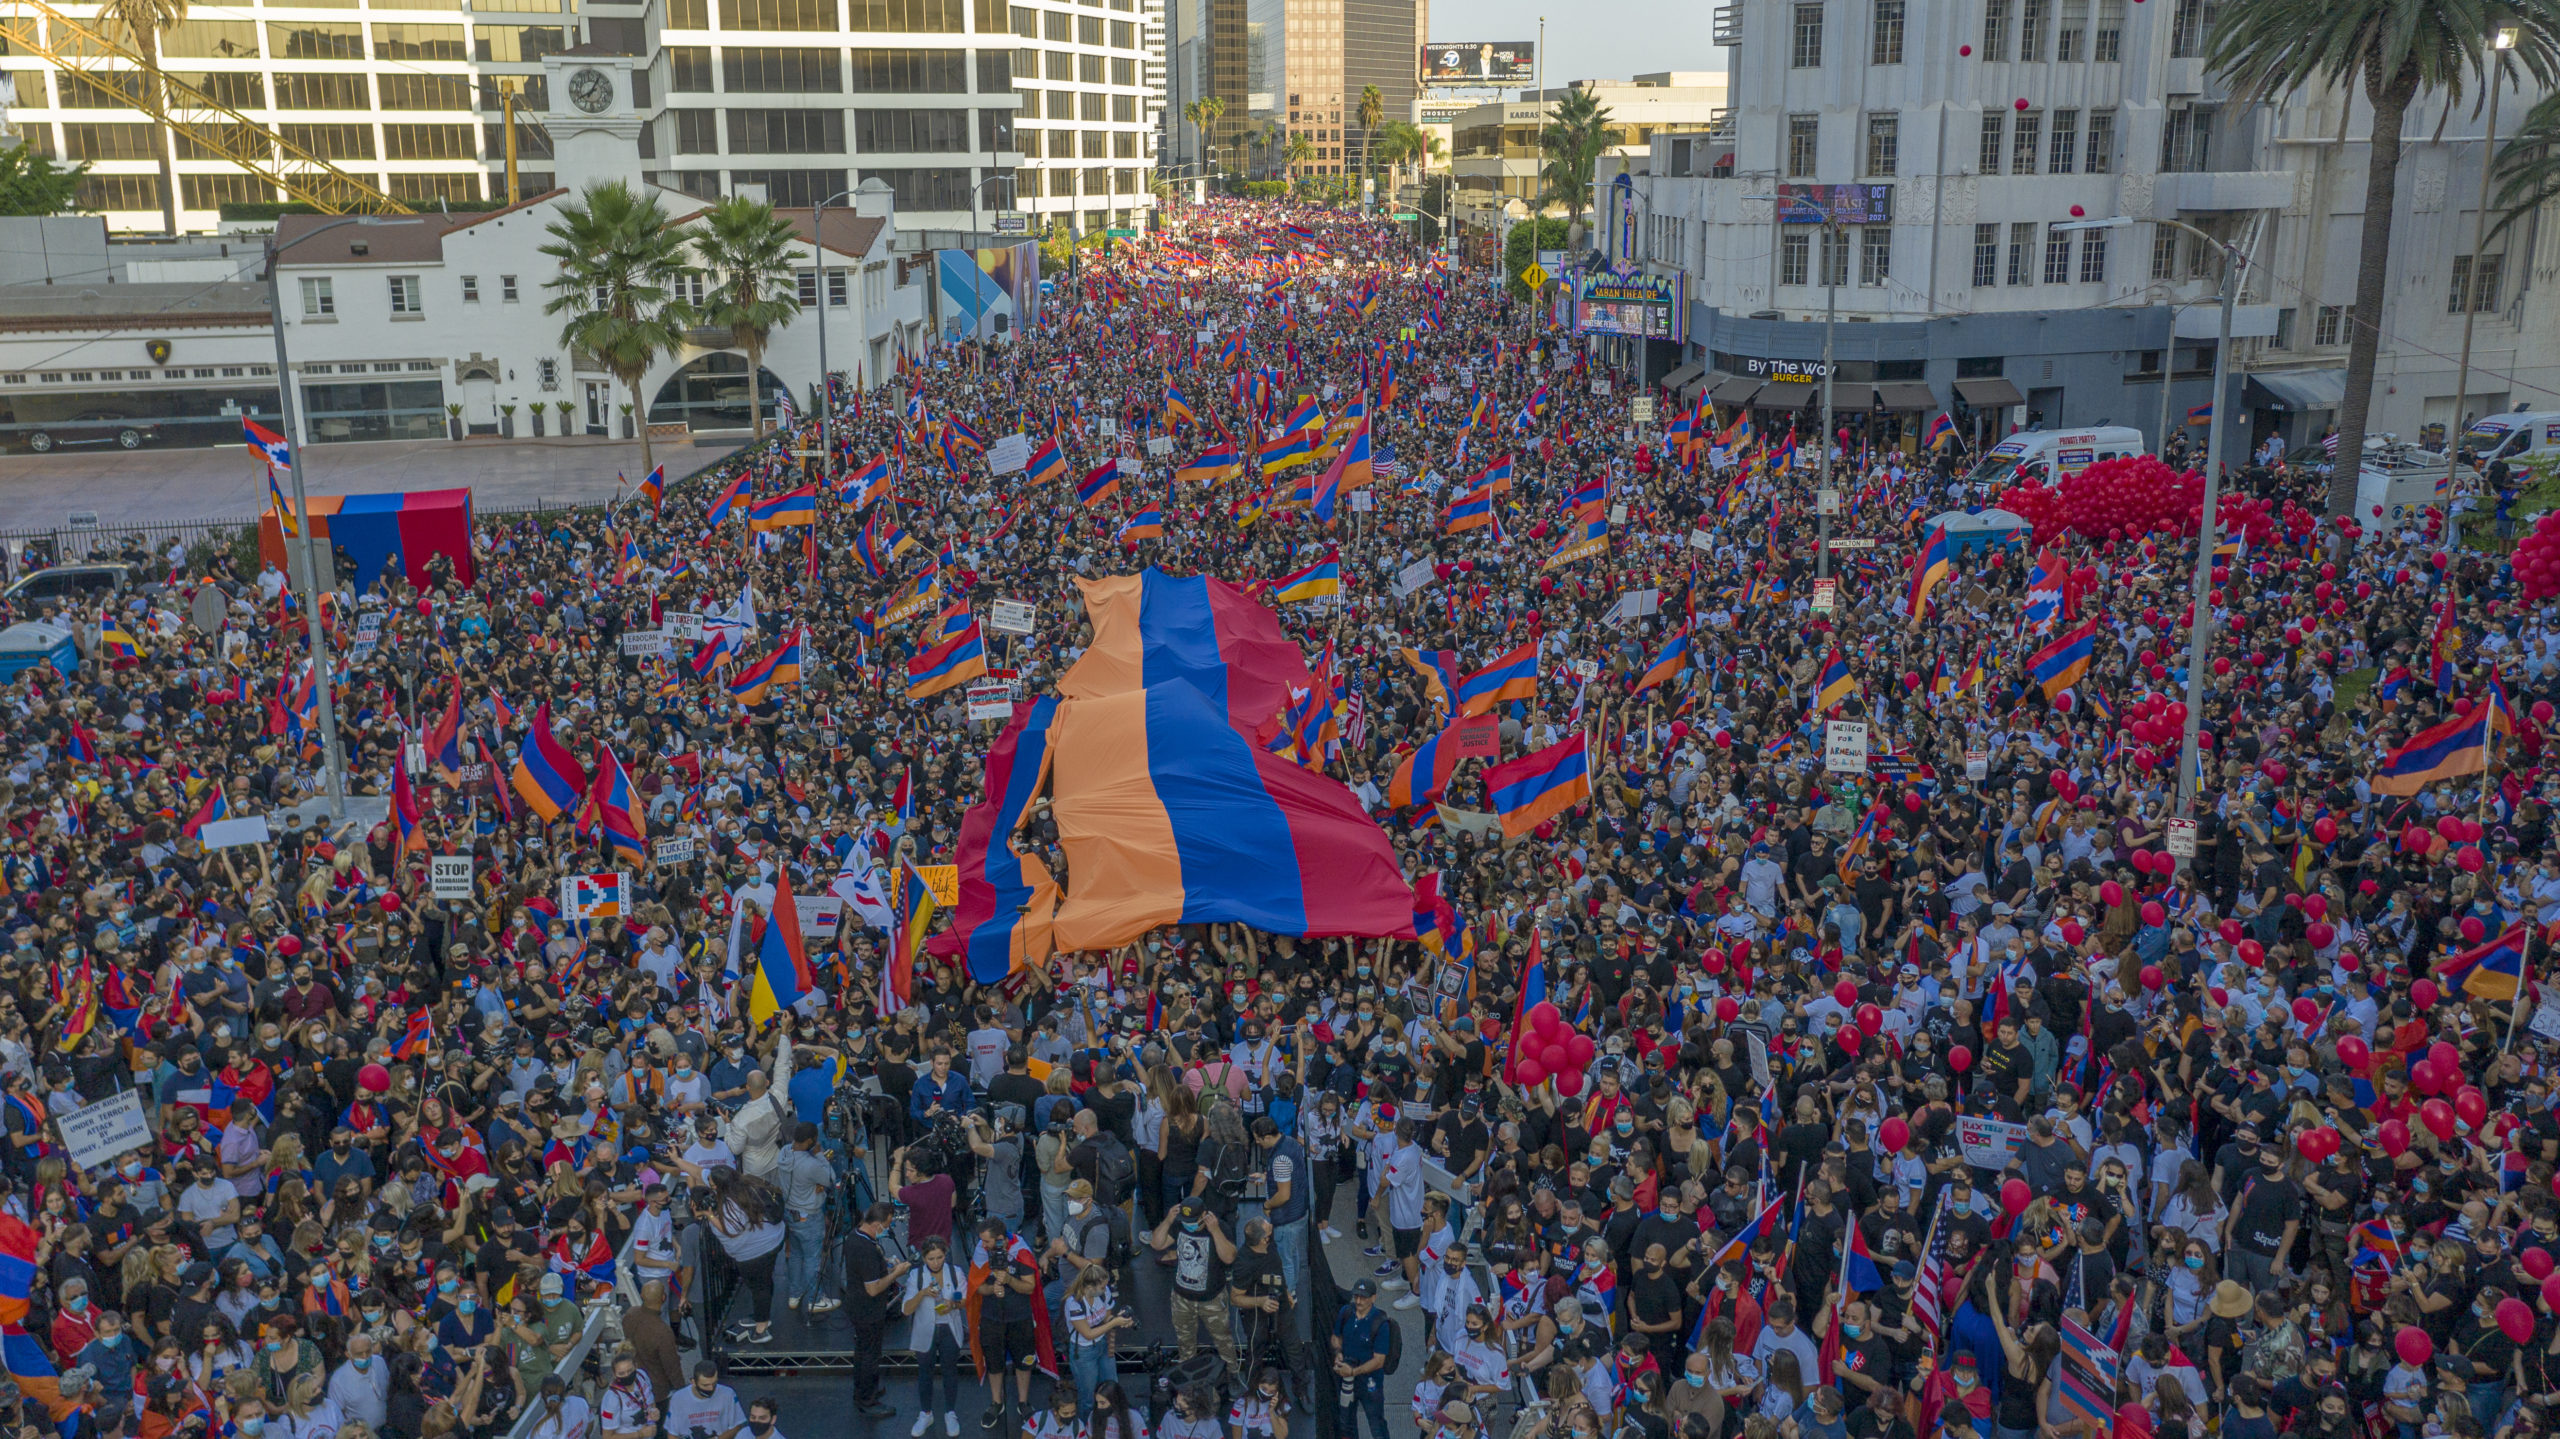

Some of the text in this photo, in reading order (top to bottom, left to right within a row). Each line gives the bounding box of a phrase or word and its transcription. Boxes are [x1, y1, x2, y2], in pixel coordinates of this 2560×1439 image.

[1872, 186, 1886, 198] OCT
[1875, 202, 1883, 212] 16
[1595, 288, 1658, 300] SABAN THEARE
[1657, 308, 1668, 316] OCT
[1748, 360, 1767, 374] By
[1770, 361, 1798, 374] The
[1772, 373, 1812, 383] BURGER
[2060, 434, 2096, 445] PRIVATE PARTY?
[676, 614, 692, 624] TURKEY
[694, 618, 702, 626] OUT
[358, 630, 376, 642] KILLS
[674, 626, 692, 636] NATO
[625, 643, 658, 653] TERRORIST
[988, 669, 1022, 680] TLER'S
[1002, 678, 1022, 686] FACE
[1833, 724, 1862, 732] MEXICO
[1460, 734, 1490, 742] DEMAND
[1462, 740, 1488, 748] JUSTICE
[1830, 746, 1862, 756] ARMENIA
[2171, 834, 2192, 843] STOPPING
[658, 840, 692, 855] TURKEY
[658, 850, 694, 864] TERRORIST
[435, 864, 469, 876] STOP
[62, 1090, 135, 1124] ARMENIAN KIDS ARE
[69, 1104, 131, 1133] UNDER TERROR
[87, 1121, 114, 1136] ATTACK
[100, 1130, 109, 1138] BY
[103, 1125, 145, 1146] AZERBAIJAN
